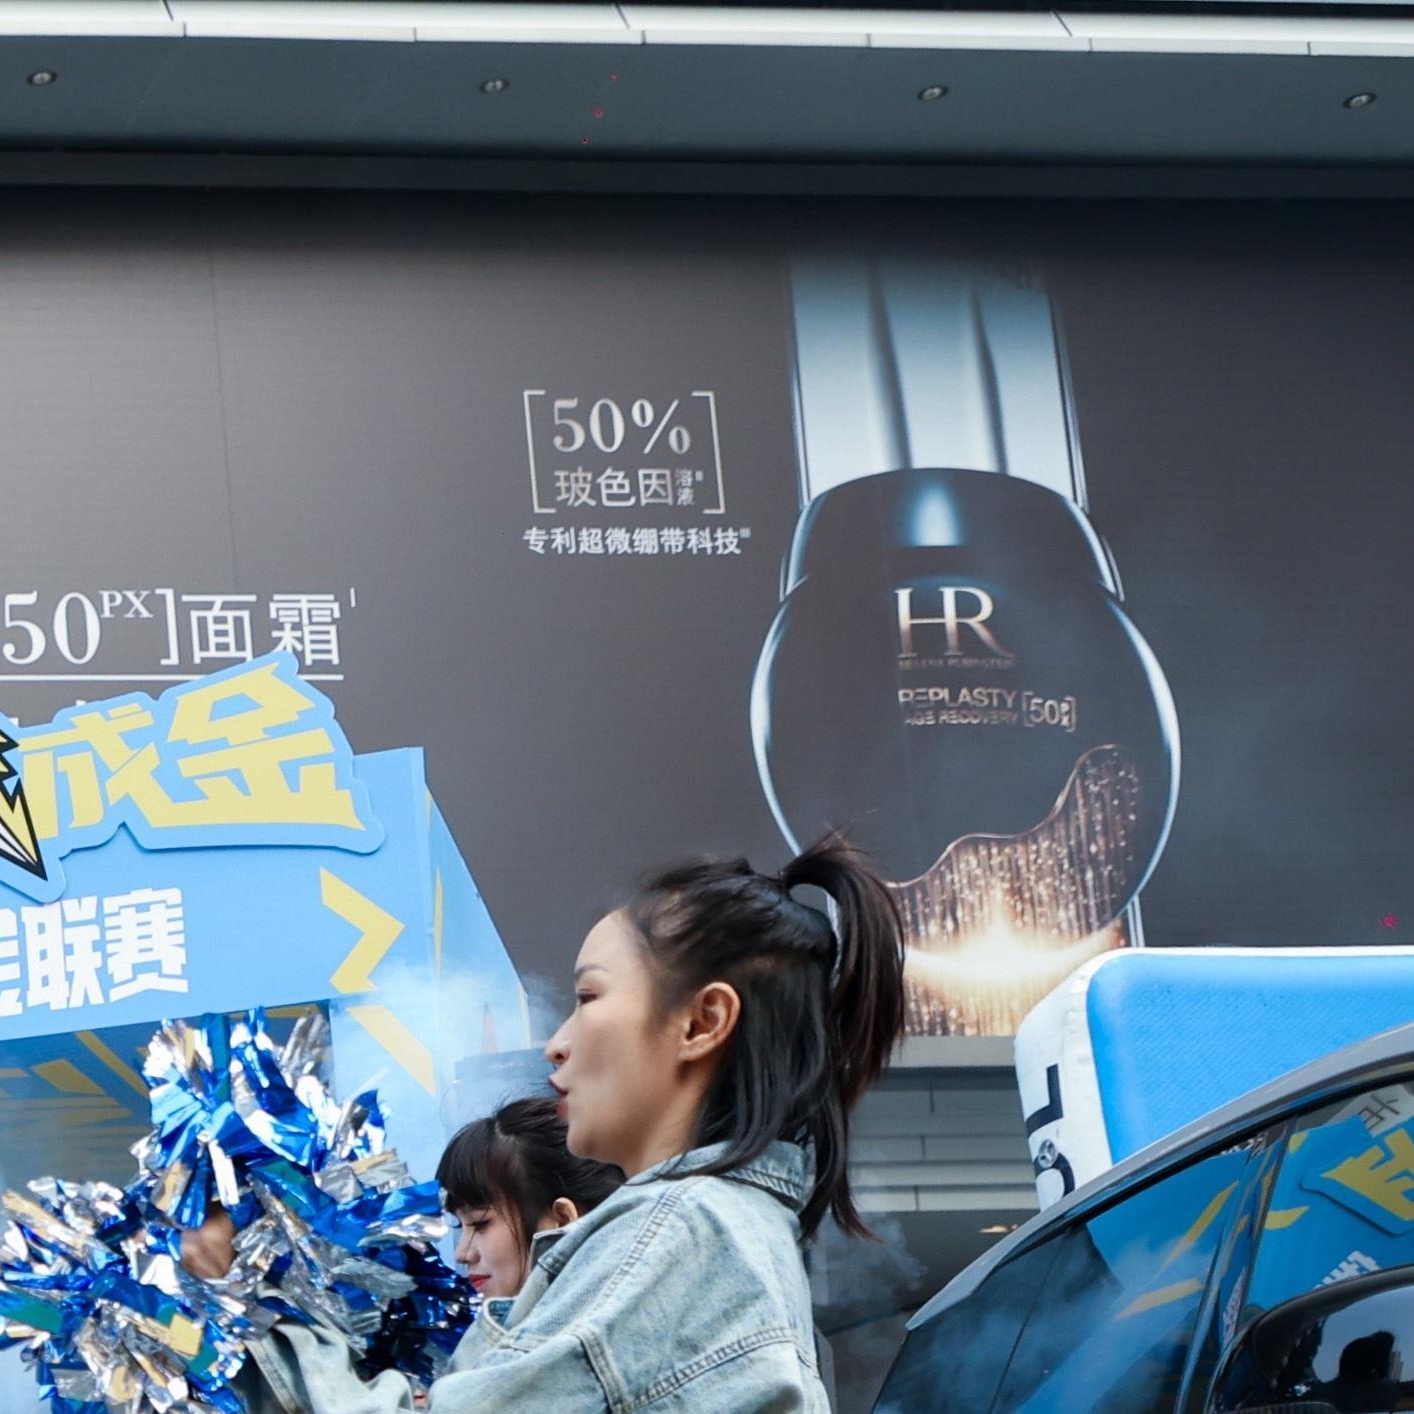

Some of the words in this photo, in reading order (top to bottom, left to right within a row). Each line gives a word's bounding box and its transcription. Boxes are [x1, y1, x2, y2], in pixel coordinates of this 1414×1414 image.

[553, 397, 691, 454] 50%
[554, 466, 673, 507] 玻色因
[895, 586, 1014, 658] HR
